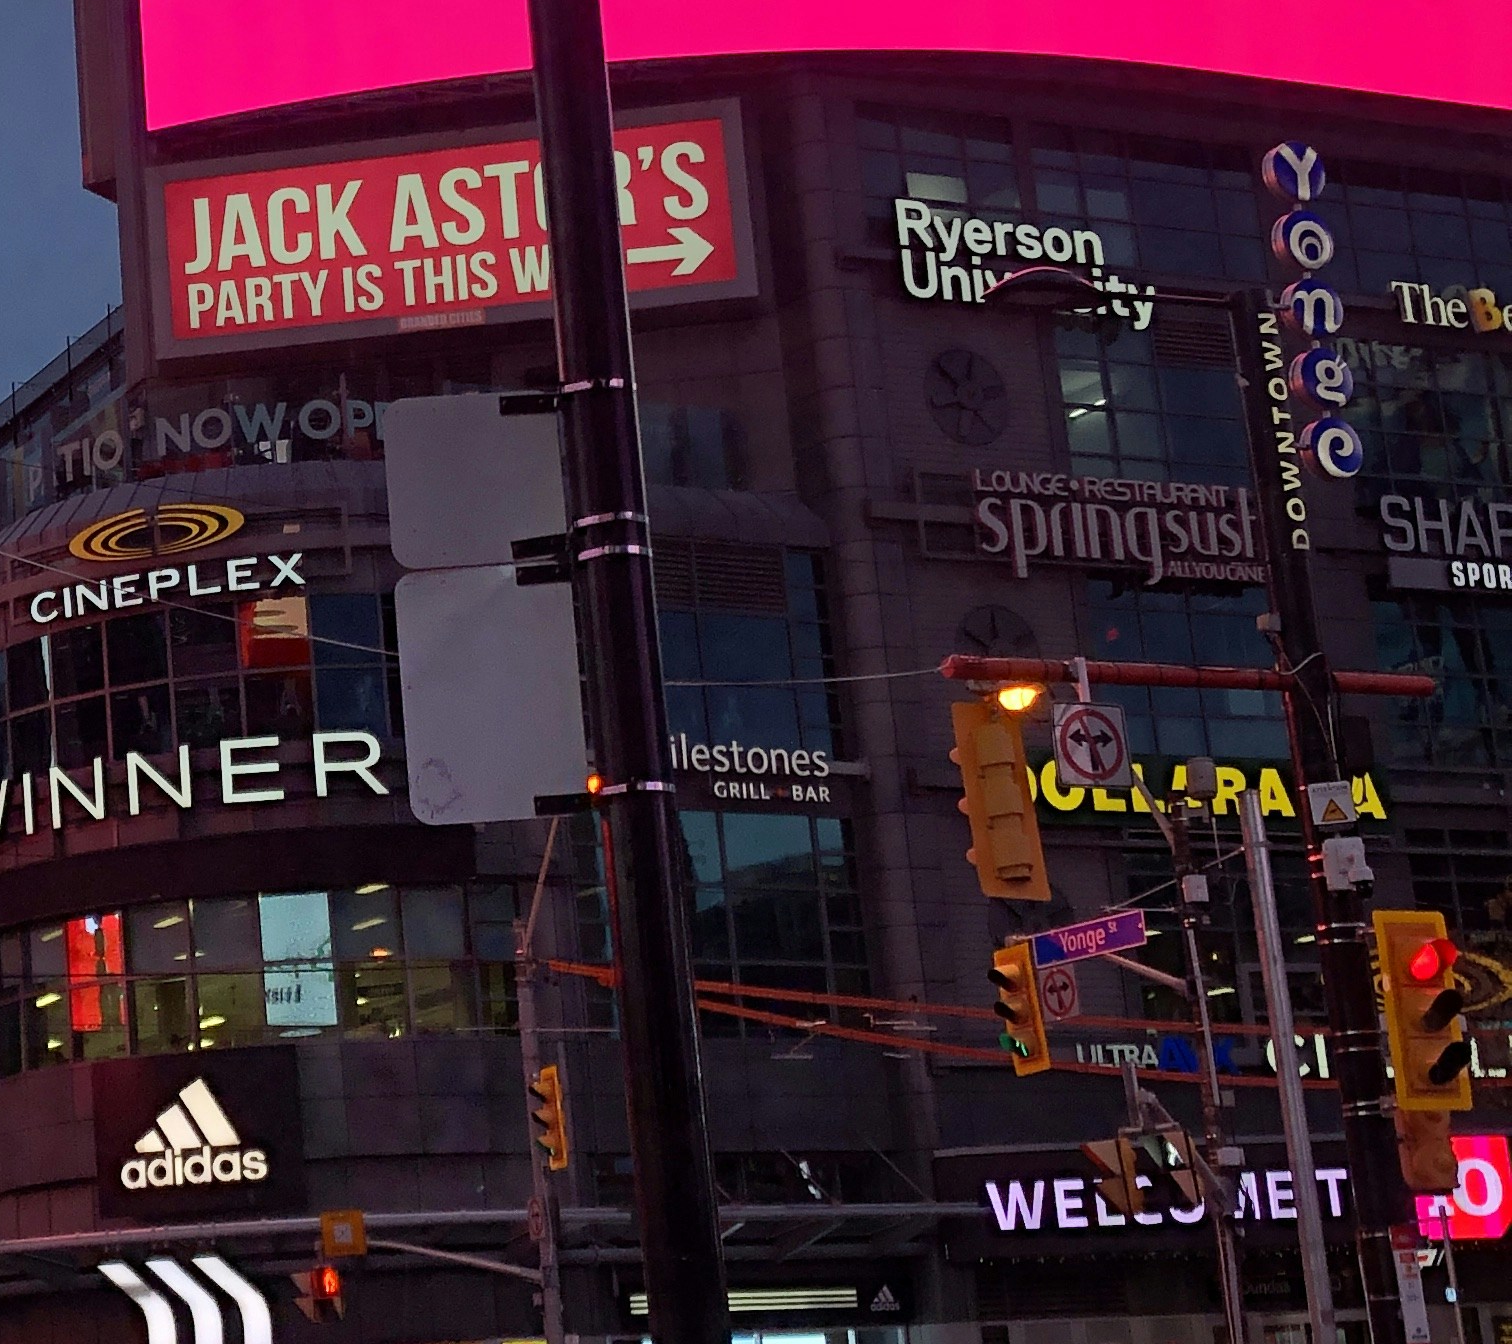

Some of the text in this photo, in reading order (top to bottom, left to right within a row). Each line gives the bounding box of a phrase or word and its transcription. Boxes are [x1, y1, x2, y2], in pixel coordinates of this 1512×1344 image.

[184, 178, 368, 275] JACK
[895, 199, 1104, 265] Ryerson
[188, 268, 329, 330] PARTY
[342, 264, 384, 313] IS
[393, 251, 498, 308] THIS
[1278, 142, 1363, 478] Yonge
[1391, 280, 1469, 329] The
[156, 402, 287, 456] NOW
[1258, 312, 1310, 550] DOWNTOWN
[975, 468, 1229, 507] LOUNGE RESTAURANT
[30, 553, 305, 624] CINEPLEX
[714, 781, 831, 802] GRILL BAR
[1059, 926, 1106, 953] Yonge
[120, 1145, 268, 1189] adidas
